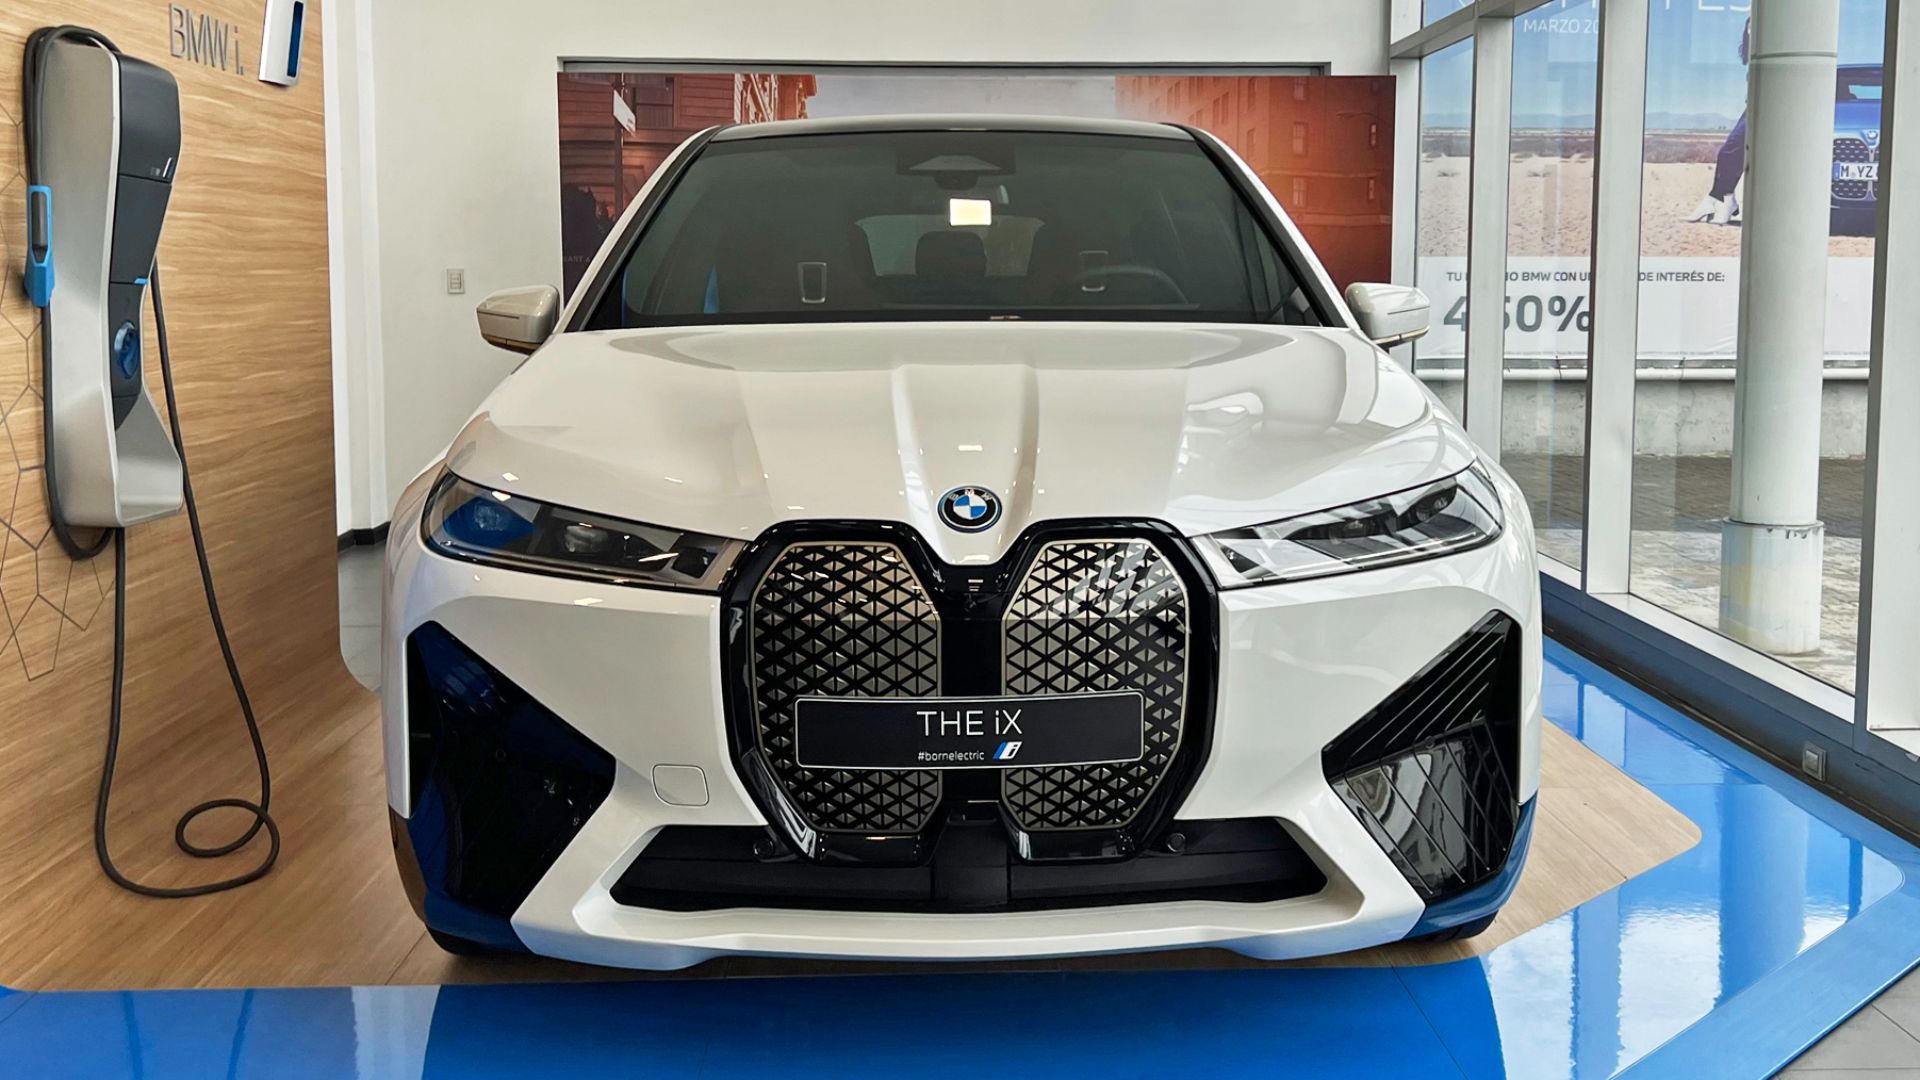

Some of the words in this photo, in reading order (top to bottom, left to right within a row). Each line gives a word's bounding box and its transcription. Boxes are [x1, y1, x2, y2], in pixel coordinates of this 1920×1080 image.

[1524, 19, 1580, 33] MARZO
[169, 3, 228, 72] BMW
[1446, 272, 1462, 281] TU
[1522, 272, 1551, 281] BMW
[1553, 272, 1577, 281] CON
[1656, 270, 1705, 281] INTERÉS
[1707, 272, 1725, 282] DE:
[948, 488, 993, 501] BMW
[916, 710, 984, 736] THE
[995, 709, 1022, 735] iX
[917, 750, 985, 761] #bornelectric
